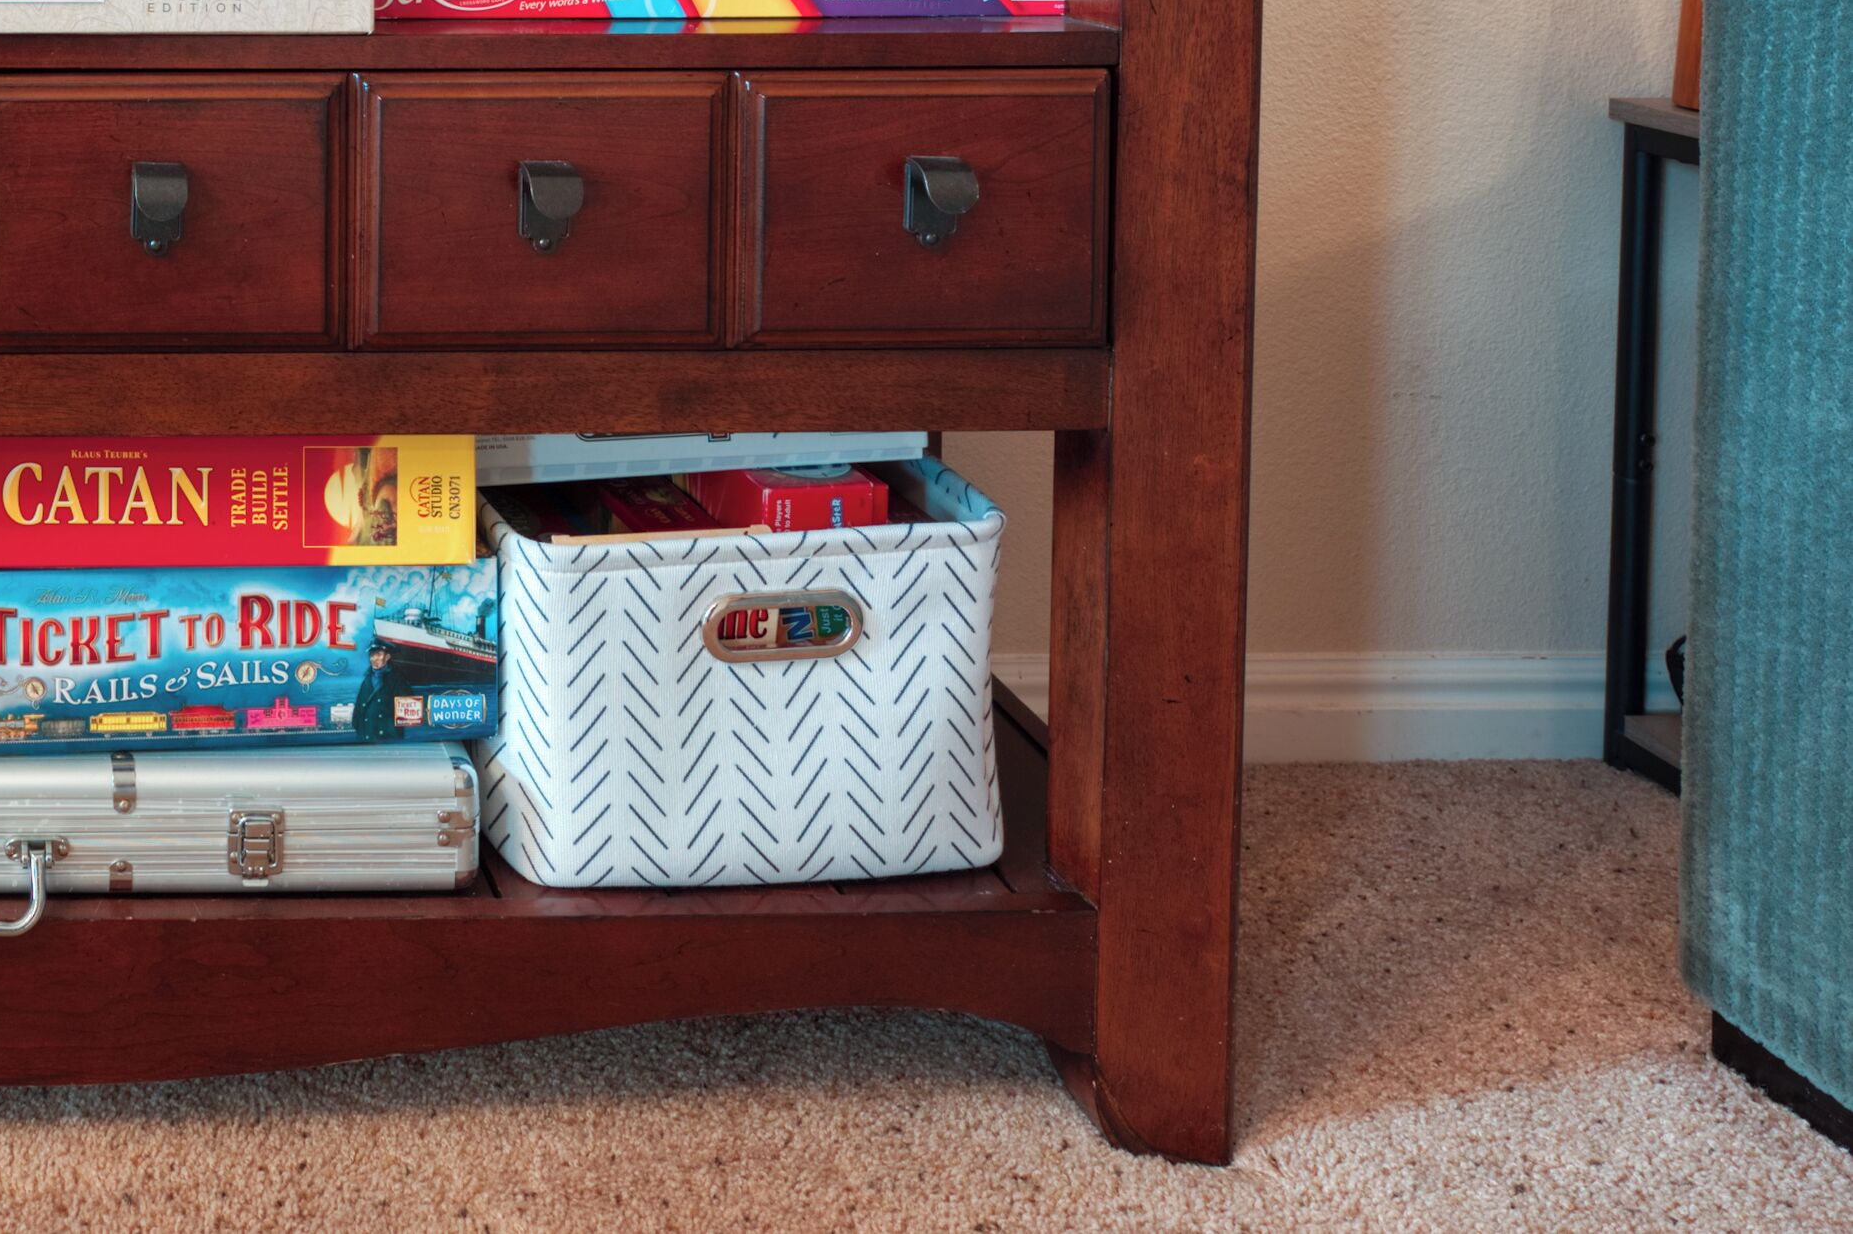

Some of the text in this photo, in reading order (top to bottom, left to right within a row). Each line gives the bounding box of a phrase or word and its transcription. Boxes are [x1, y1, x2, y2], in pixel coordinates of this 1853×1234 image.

[147, 2, 242, 13] EDITION
[518, 0, 546, 12] Every
[71, 449, 101, 459] KLAUS
[2, 462, 213, 527] CATAN
[230, 468, 246, 528] TRADE
[252, 470, 267, 525] BUILD
[272, 466, 288, 531] SETTLE
[417, 476, 430, 518] CATAN
[431, 475, 442, 518] STUDIO
[449, 476, 461, 520] CN3071
[775, 499, 783, 526] Players
[179, 613, 226, 651] TO
[237, 593, 358, 650] RIDE
[819, 608, 832, 634] Just
[53, 660, 290, 706] RAILS & SAILS
[433, 697, 480, 709] DAYS OF
[433, 709, 481, 722] WONDER
